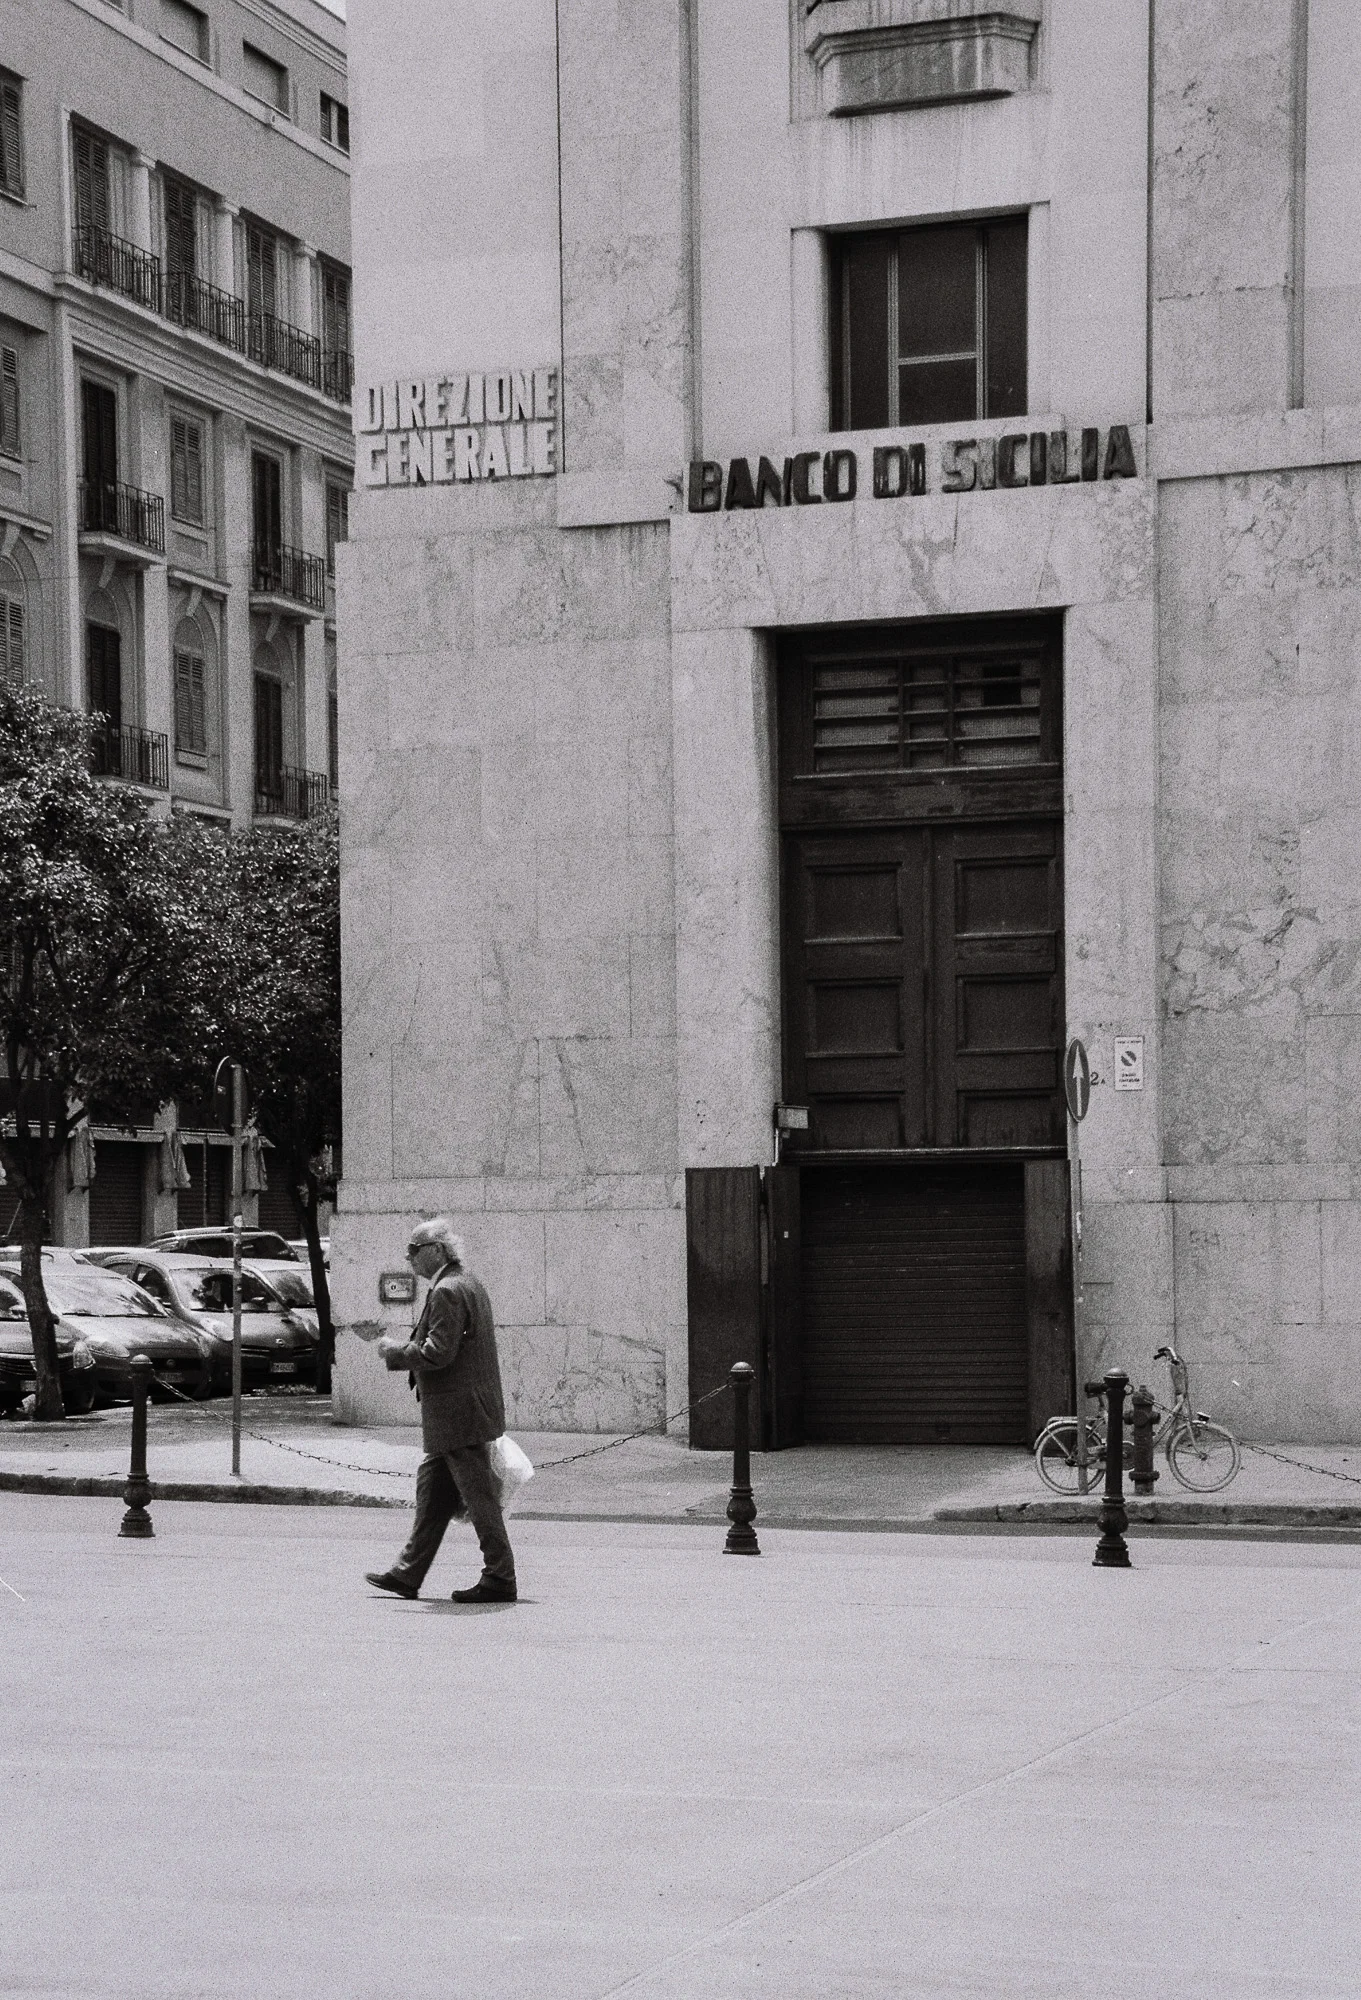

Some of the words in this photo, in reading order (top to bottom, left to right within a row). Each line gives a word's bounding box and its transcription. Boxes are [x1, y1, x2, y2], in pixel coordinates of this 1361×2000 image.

[360, 367, 557, 434] DIREZIONE
[363, 421, 557, 488] GENERALE
[688, 449, 857, 513] BANCO
[873, 442, 926, 499] DI
[941, 424, 1138, 494] SICILIA
